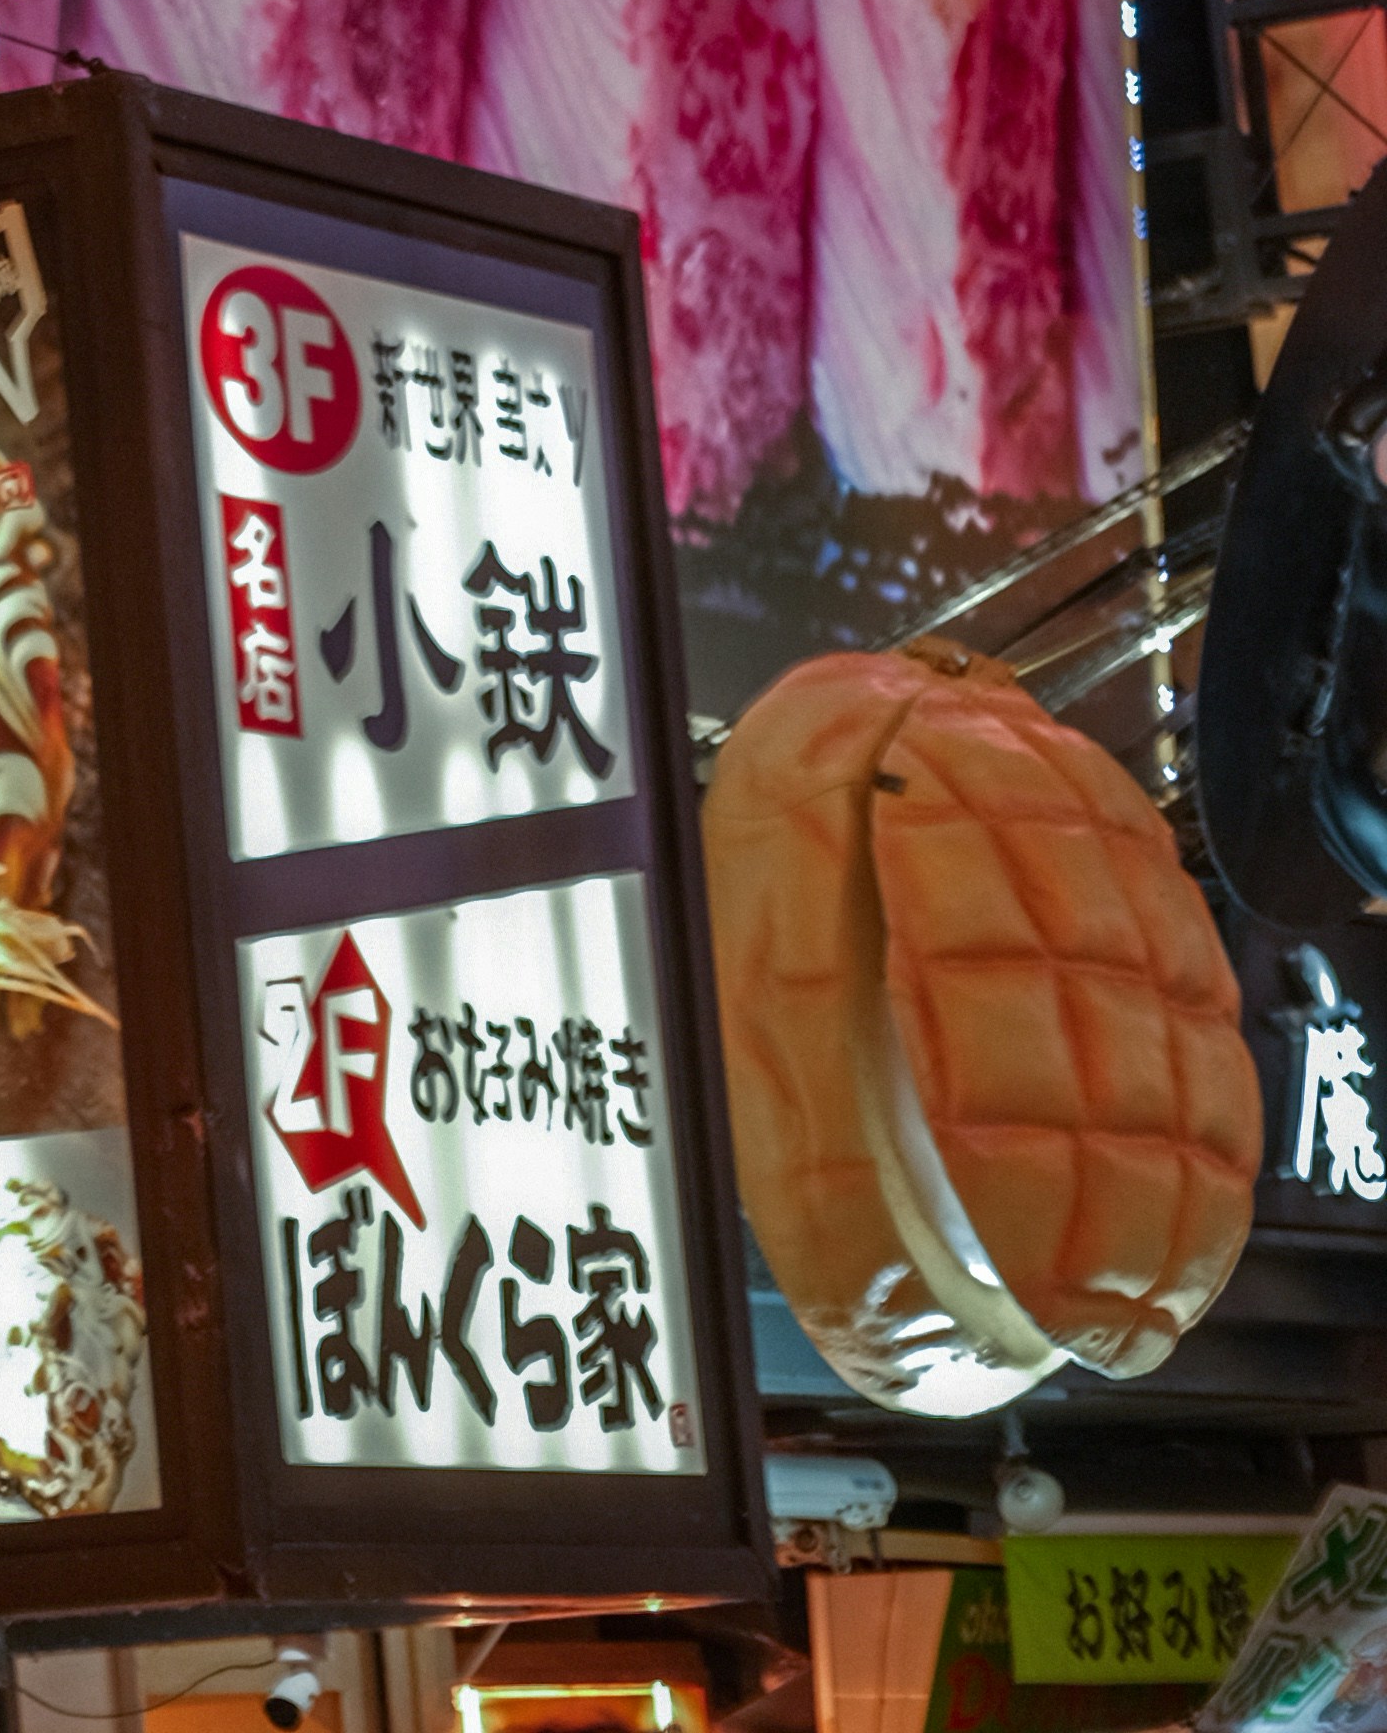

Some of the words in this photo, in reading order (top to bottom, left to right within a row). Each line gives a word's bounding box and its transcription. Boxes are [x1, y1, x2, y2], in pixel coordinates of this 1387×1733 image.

[220, 289, 335, 444] 3F
[230, 514, 295, 723] 名店
[320, 519, 617, 781] 小鉄
[258, 975, 380, 1138] 2F
[408, 1002, 655, 1148] お好み焼き
[281, 1185, 667, 1434] ぼんくら家
